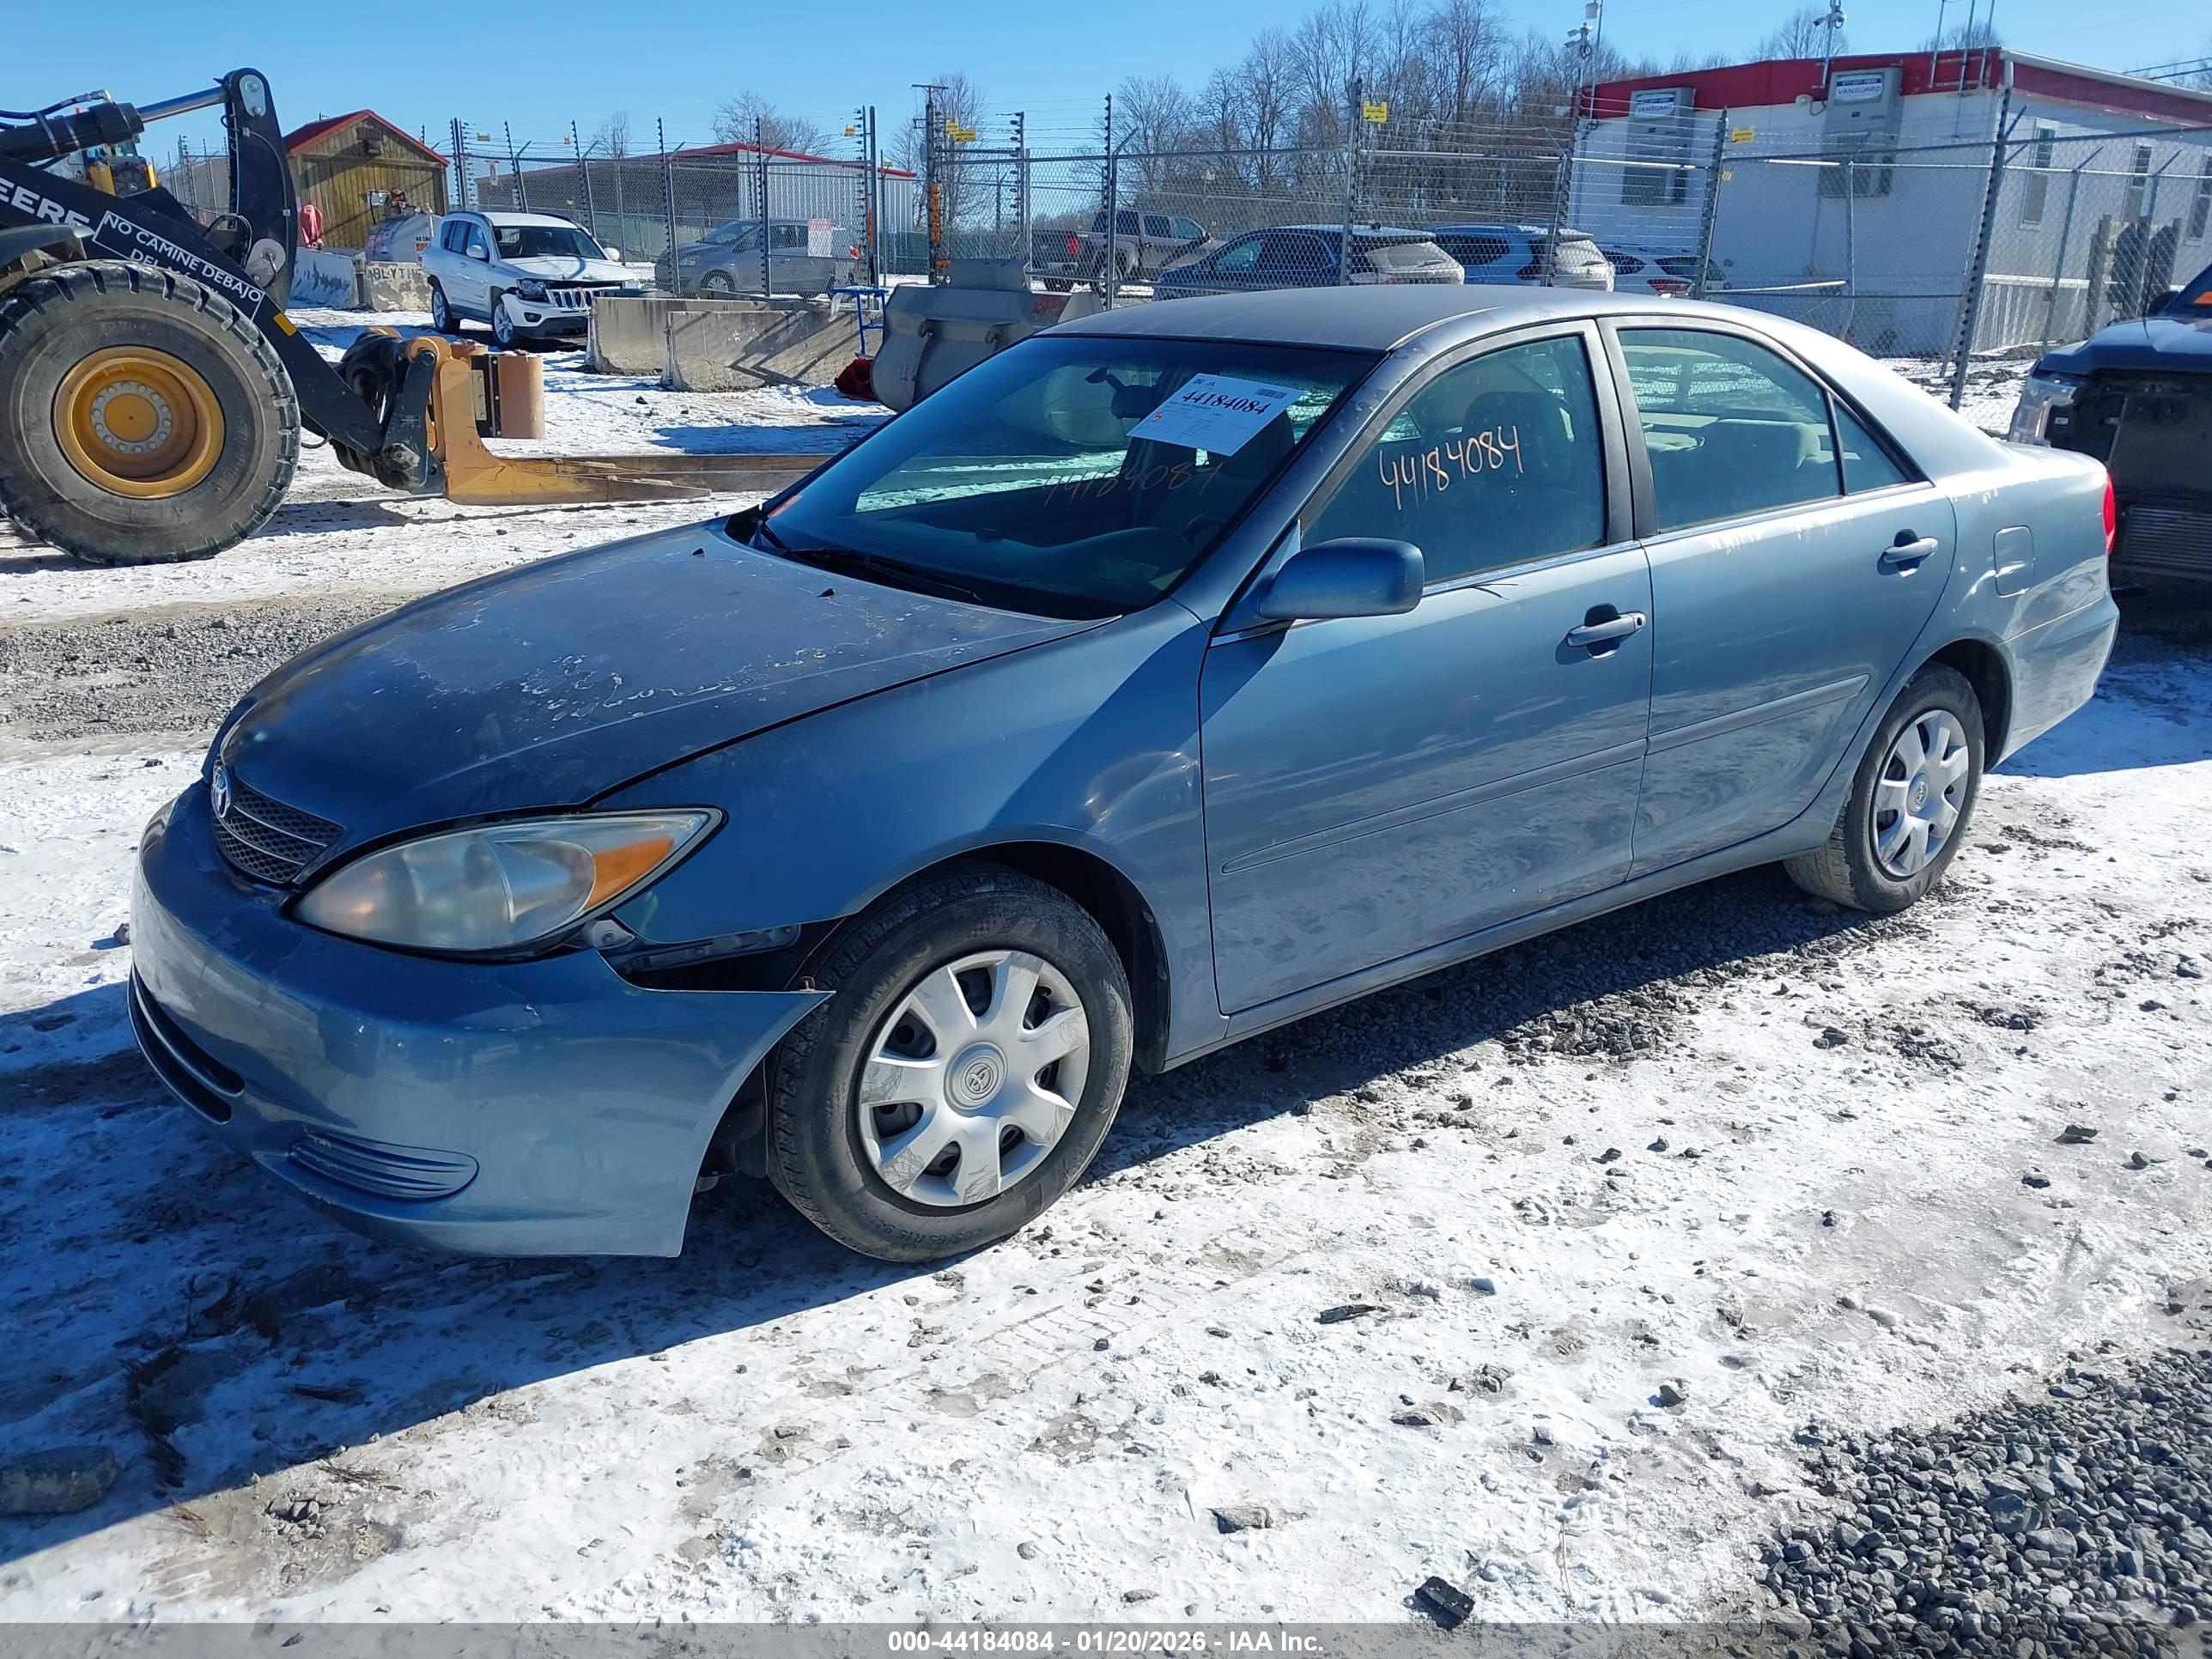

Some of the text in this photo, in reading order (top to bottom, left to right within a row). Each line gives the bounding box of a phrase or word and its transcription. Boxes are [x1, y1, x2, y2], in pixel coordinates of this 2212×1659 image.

[1838, 85, 1881, 95] VANGUARD
[103, 213, 132, 235] NO
[136, 230, 200, 271] CAMINE
[203, 262, 264, 302] DEBAJO
[1182, 390, 1272, 415] 44184084
[1379, 425, 1525, 511] 44184084
